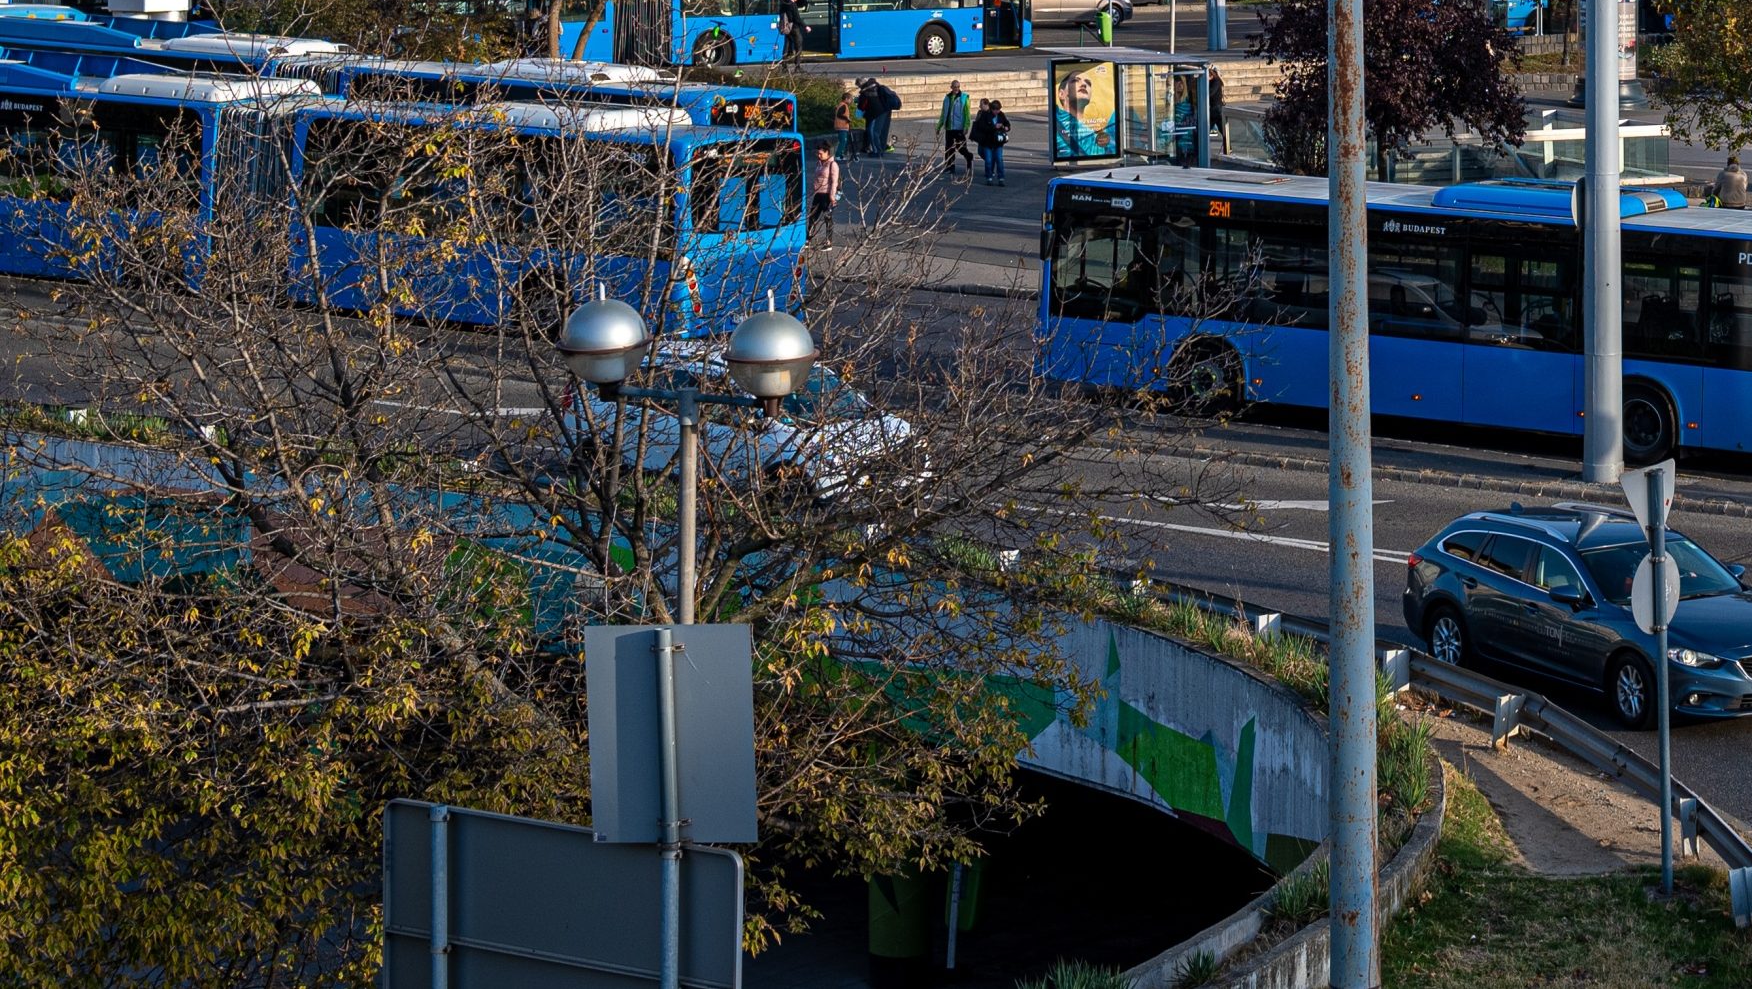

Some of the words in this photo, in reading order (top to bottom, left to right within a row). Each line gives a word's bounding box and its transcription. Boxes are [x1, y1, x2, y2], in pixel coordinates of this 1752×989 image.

[13, 102, 43, 112] BUDAPEST
[1071, 194, 1092, 202] MAN
[1402, 223, 1447, 235] BUDAPEST
